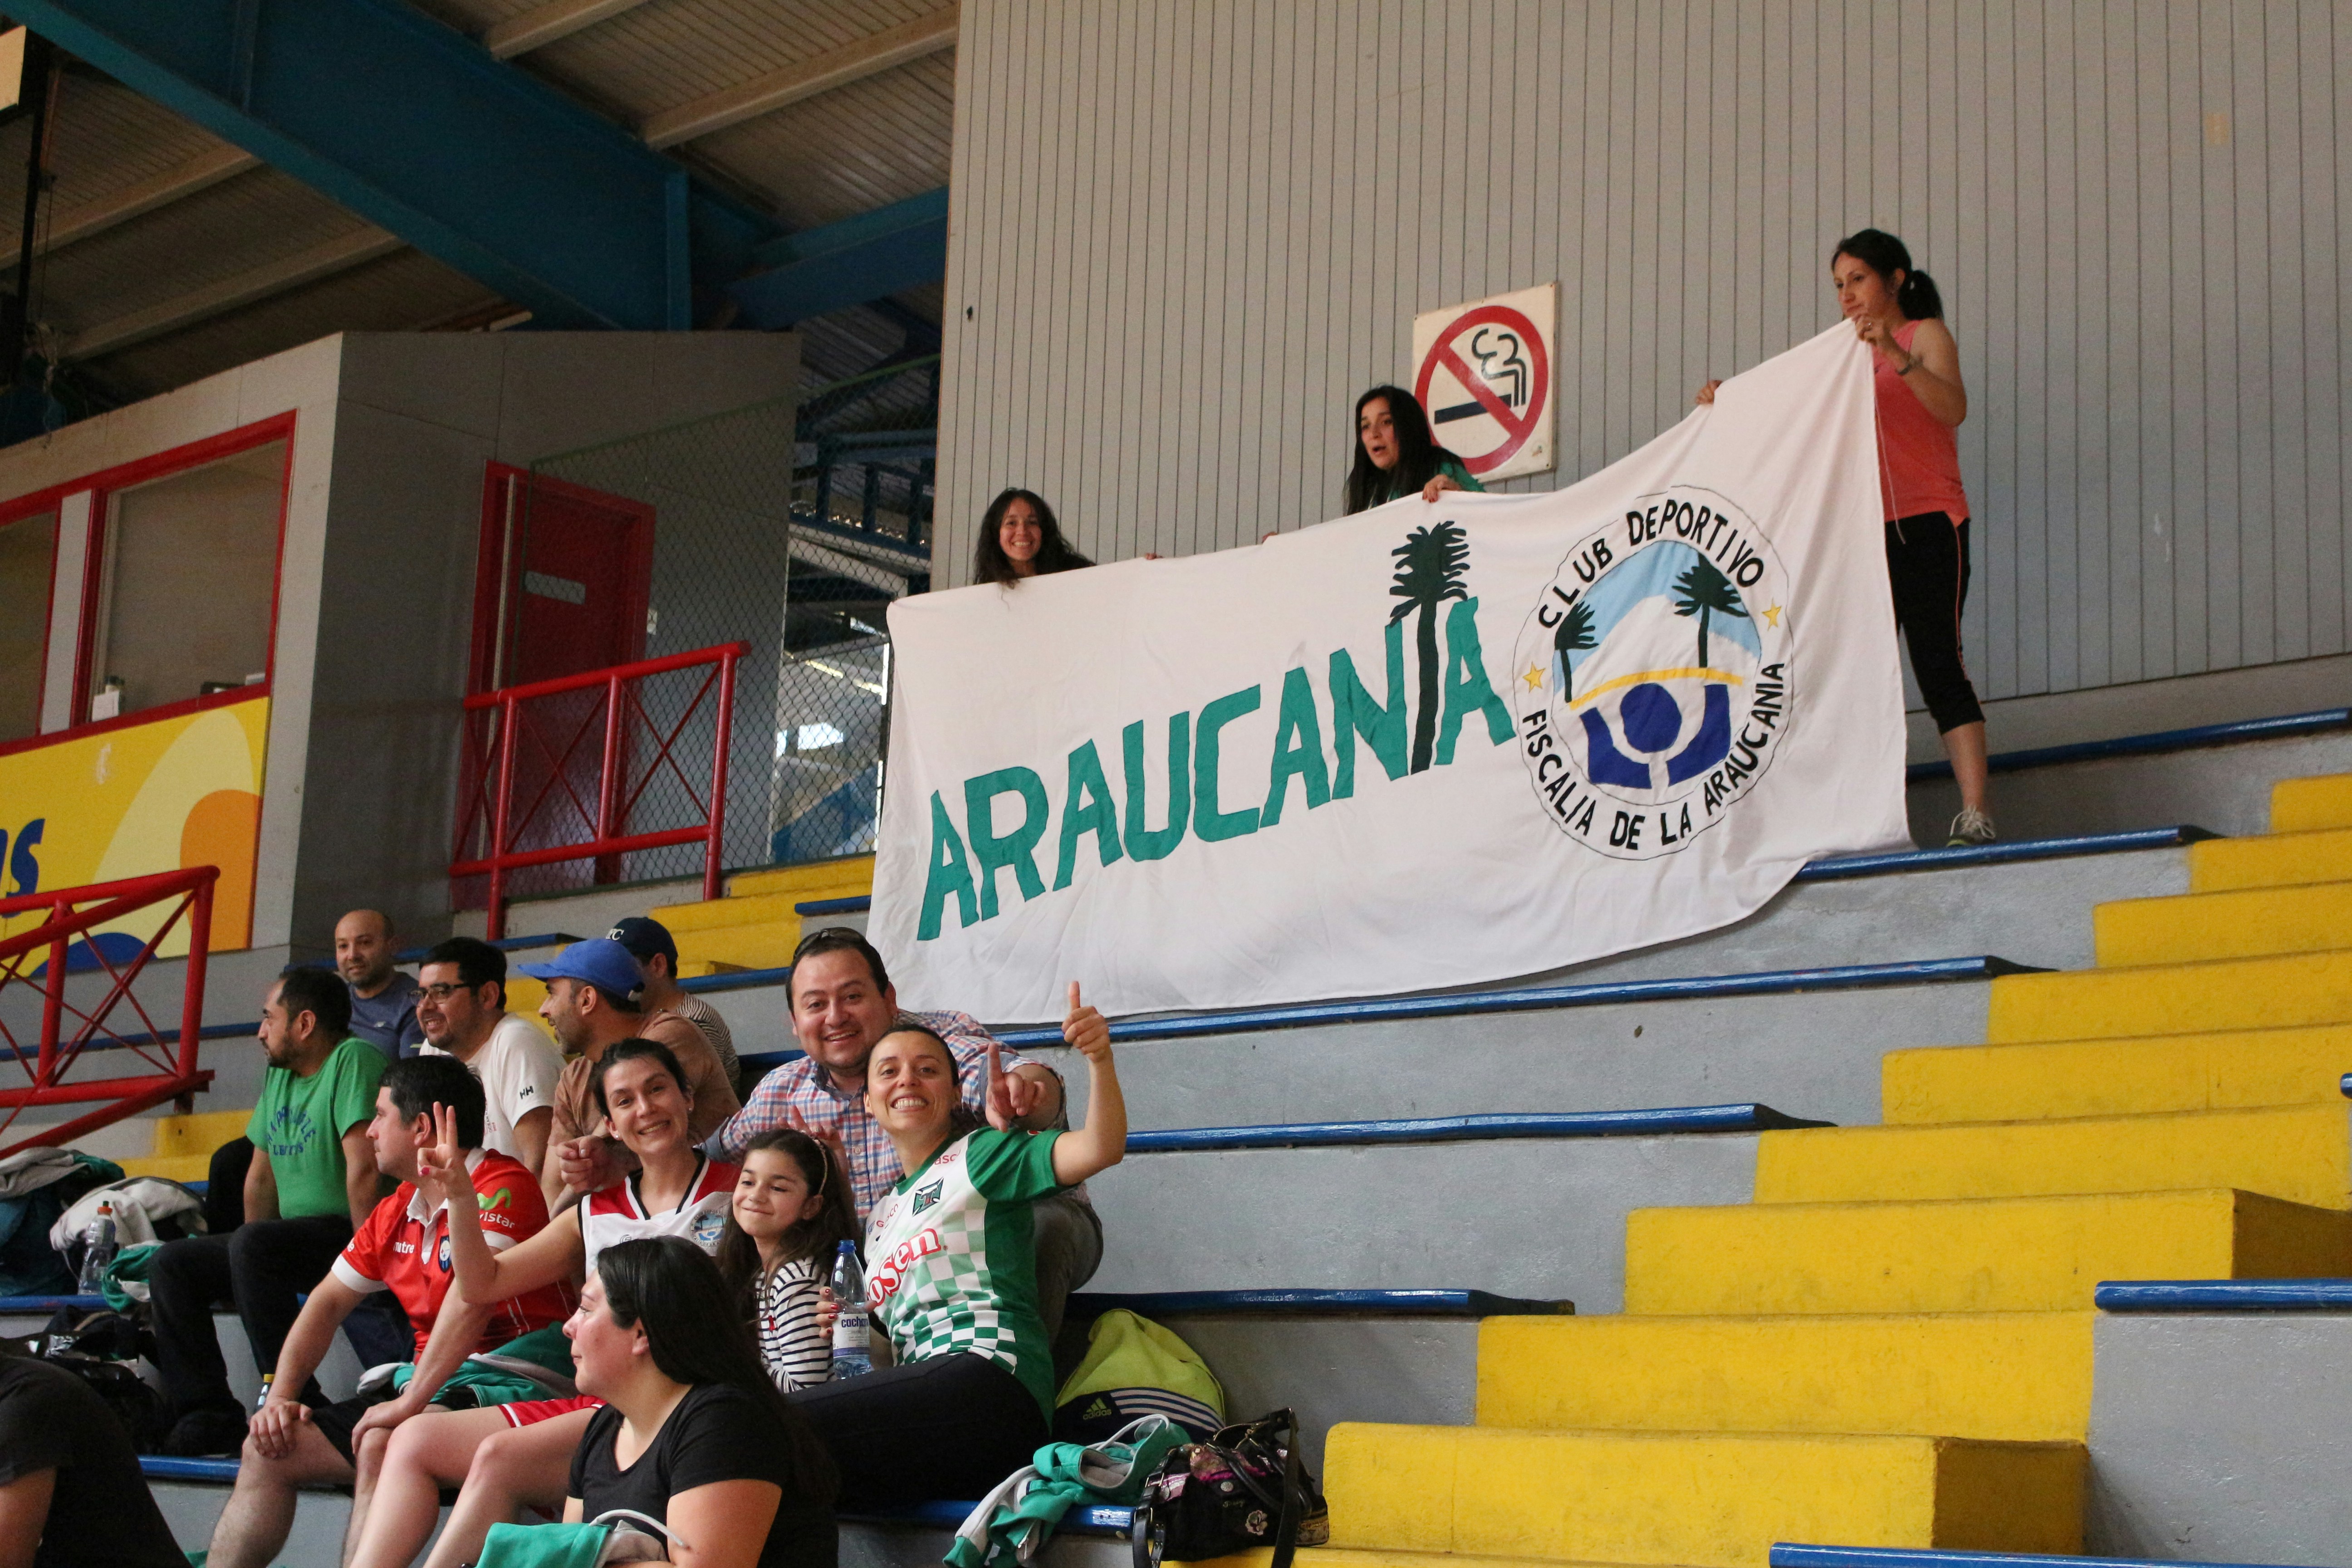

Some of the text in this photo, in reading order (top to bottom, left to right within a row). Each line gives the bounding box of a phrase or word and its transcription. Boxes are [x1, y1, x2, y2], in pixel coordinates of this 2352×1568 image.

[1539, 499, 1764, 628] CLUB DEPORTIVO
[1522, 662, 1786, 851] FISCALIA DE LA ARAUCANIA
[519, 1086, 534, 1099] HH
[479, 1211, 515, 1228] istar
[393, 1241, 415, 1254] mitre
[867, 1228, 942, 1306] osen
[1083, 1409, 1112, 1420] adidas
